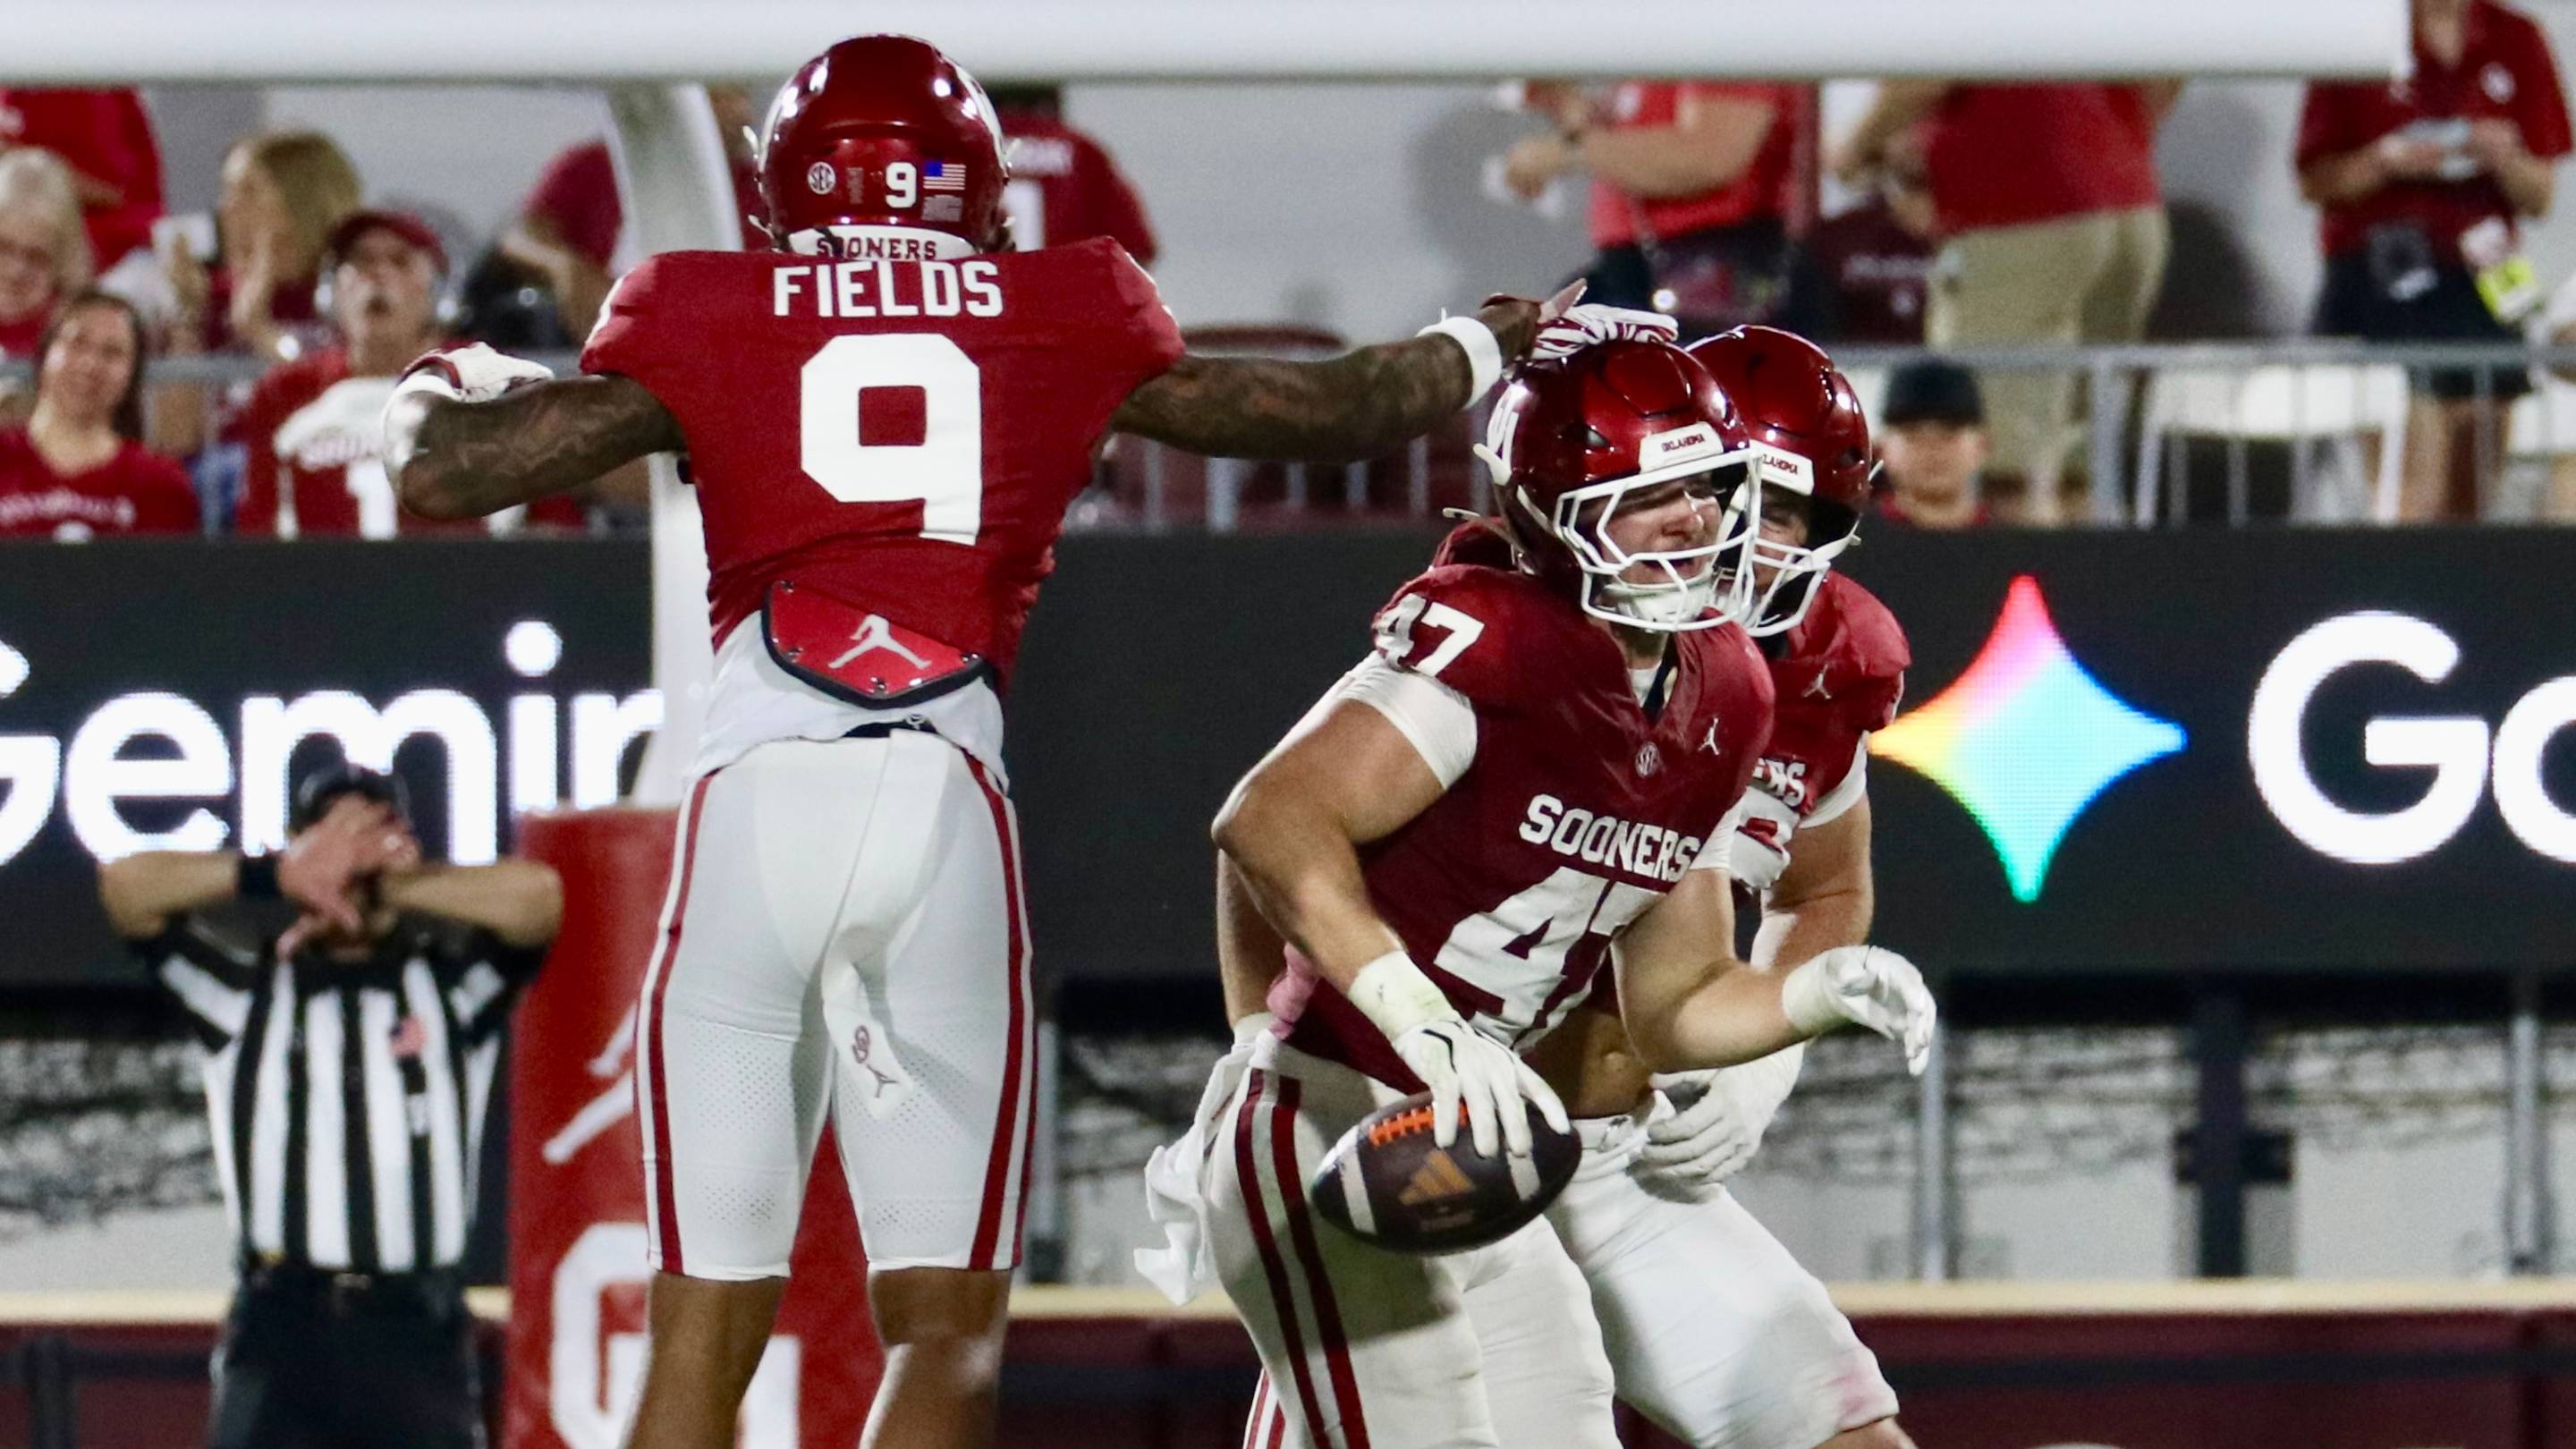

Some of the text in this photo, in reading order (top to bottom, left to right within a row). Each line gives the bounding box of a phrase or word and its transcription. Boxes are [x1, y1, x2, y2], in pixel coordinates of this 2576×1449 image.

[886, 162, 917, 208] 9
[817, 236, 936, 259] SONERS
[774, 261, 1003, 318] FIELDS
[800, 333, 982, 547] 9
[1374, 593, 1485, 678] 47
[1519, 793, 1700, 883] SOONERS
